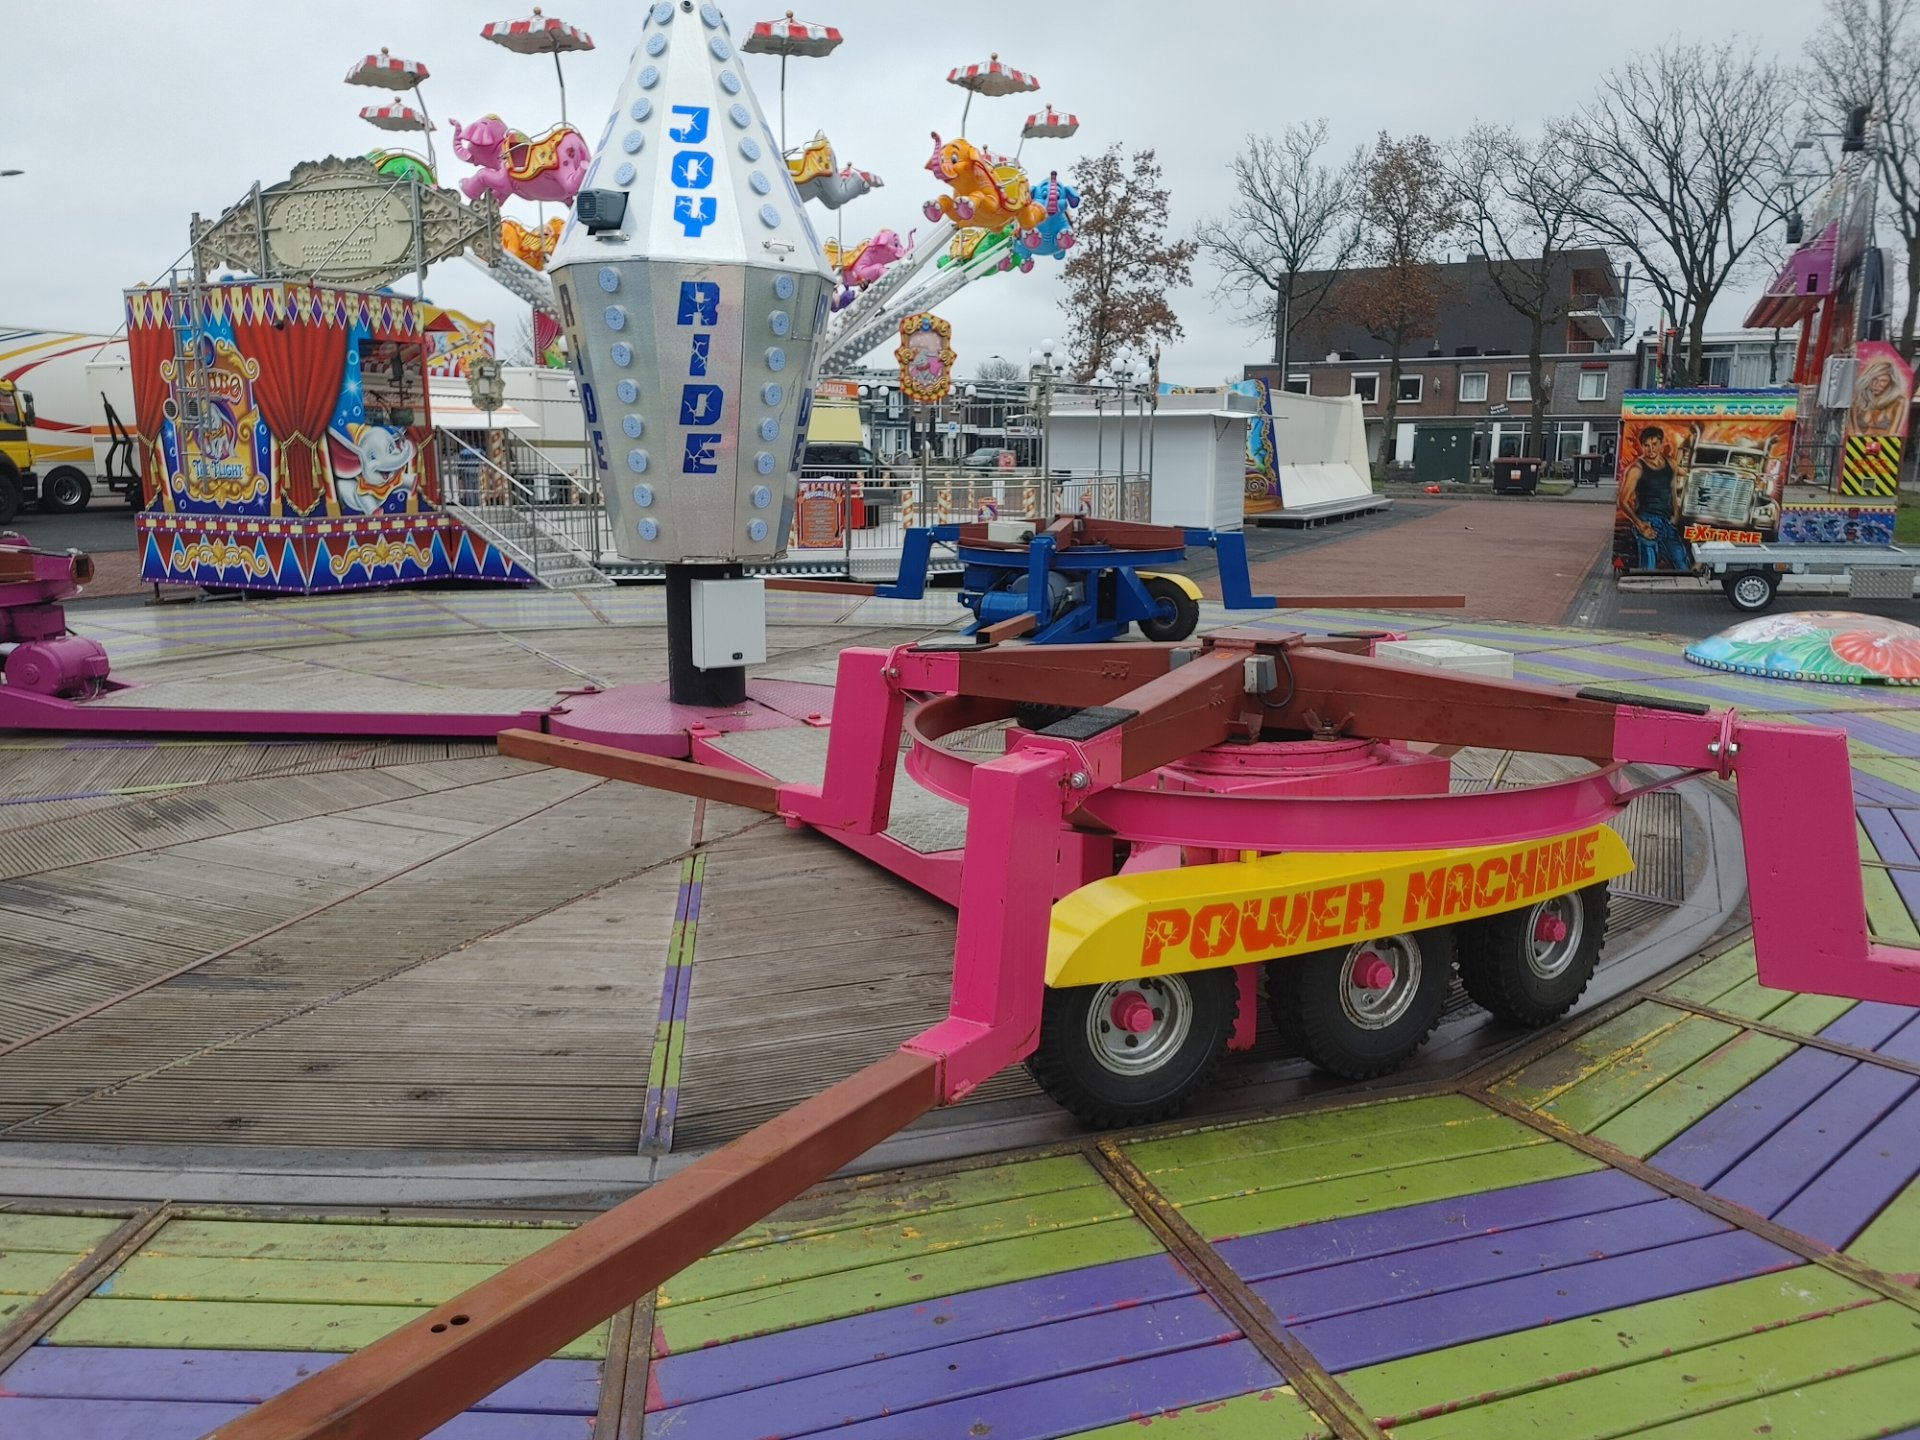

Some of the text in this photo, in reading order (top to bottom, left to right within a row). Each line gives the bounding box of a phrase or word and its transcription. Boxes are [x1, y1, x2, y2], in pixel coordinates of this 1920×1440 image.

[669, 104, 718, 238] JOY
[559, 283, 609, 471] RIDE
[676, 280, 724, 474] RIDE
[1632, 404, 1785, 416] CONTROL ROOM
[1684, 523, 1762, 545] EXTREME
[1140, 829, 1601, 967] POWER MACHINE
